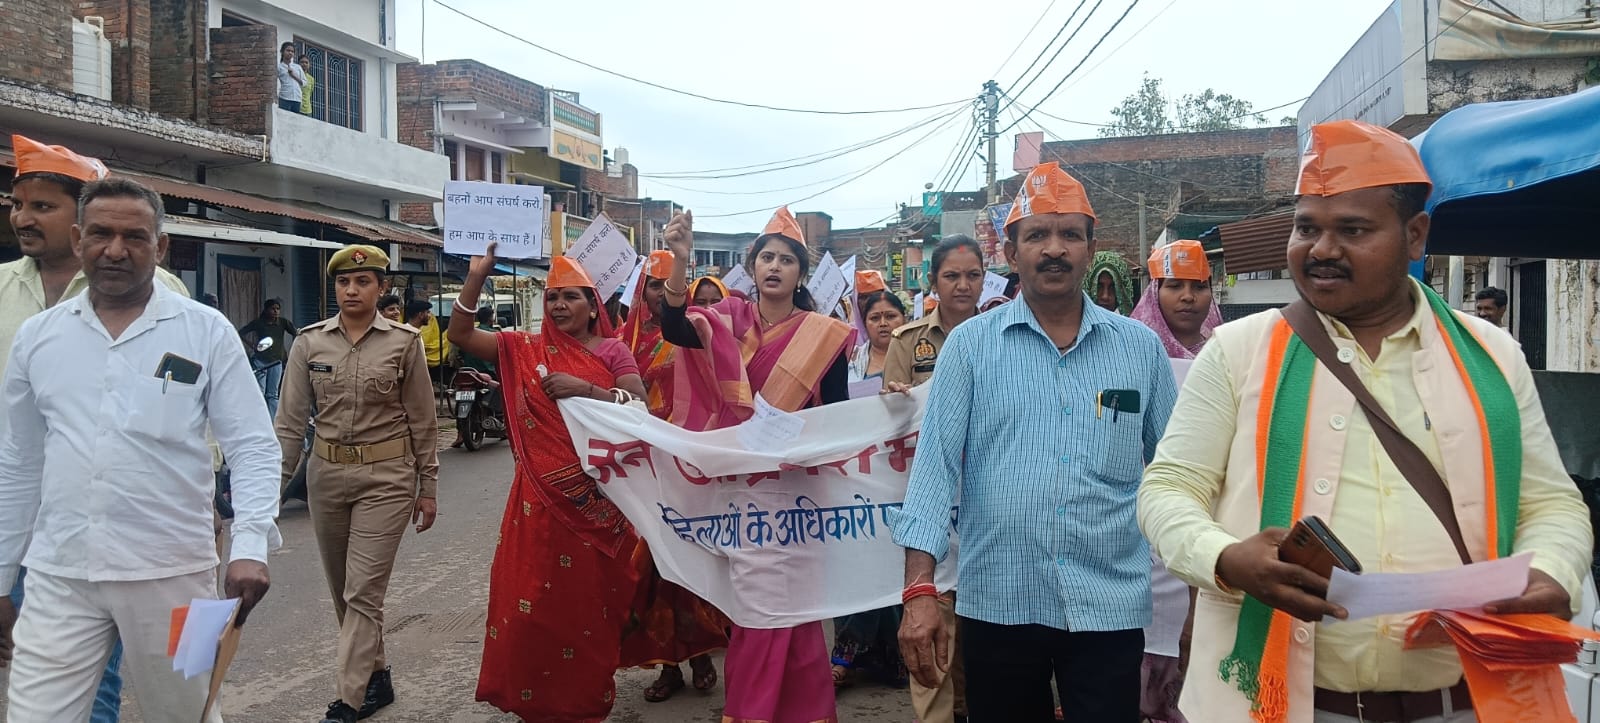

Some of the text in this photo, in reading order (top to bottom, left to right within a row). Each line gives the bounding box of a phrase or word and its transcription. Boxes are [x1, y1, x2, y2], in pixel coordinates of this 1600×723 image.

[474, 195, 493, 206] आप
[496, 195, 520, 208] संघर्ष
[448, 230, 463, 241] हम
[466, 231, 485, 241] आप
[488, 229, 498, 241] के
[500, 233, 520, 244] साथ
[747, 503, 772, 548] के
[775, 494, 876, 546] अधिकारों
